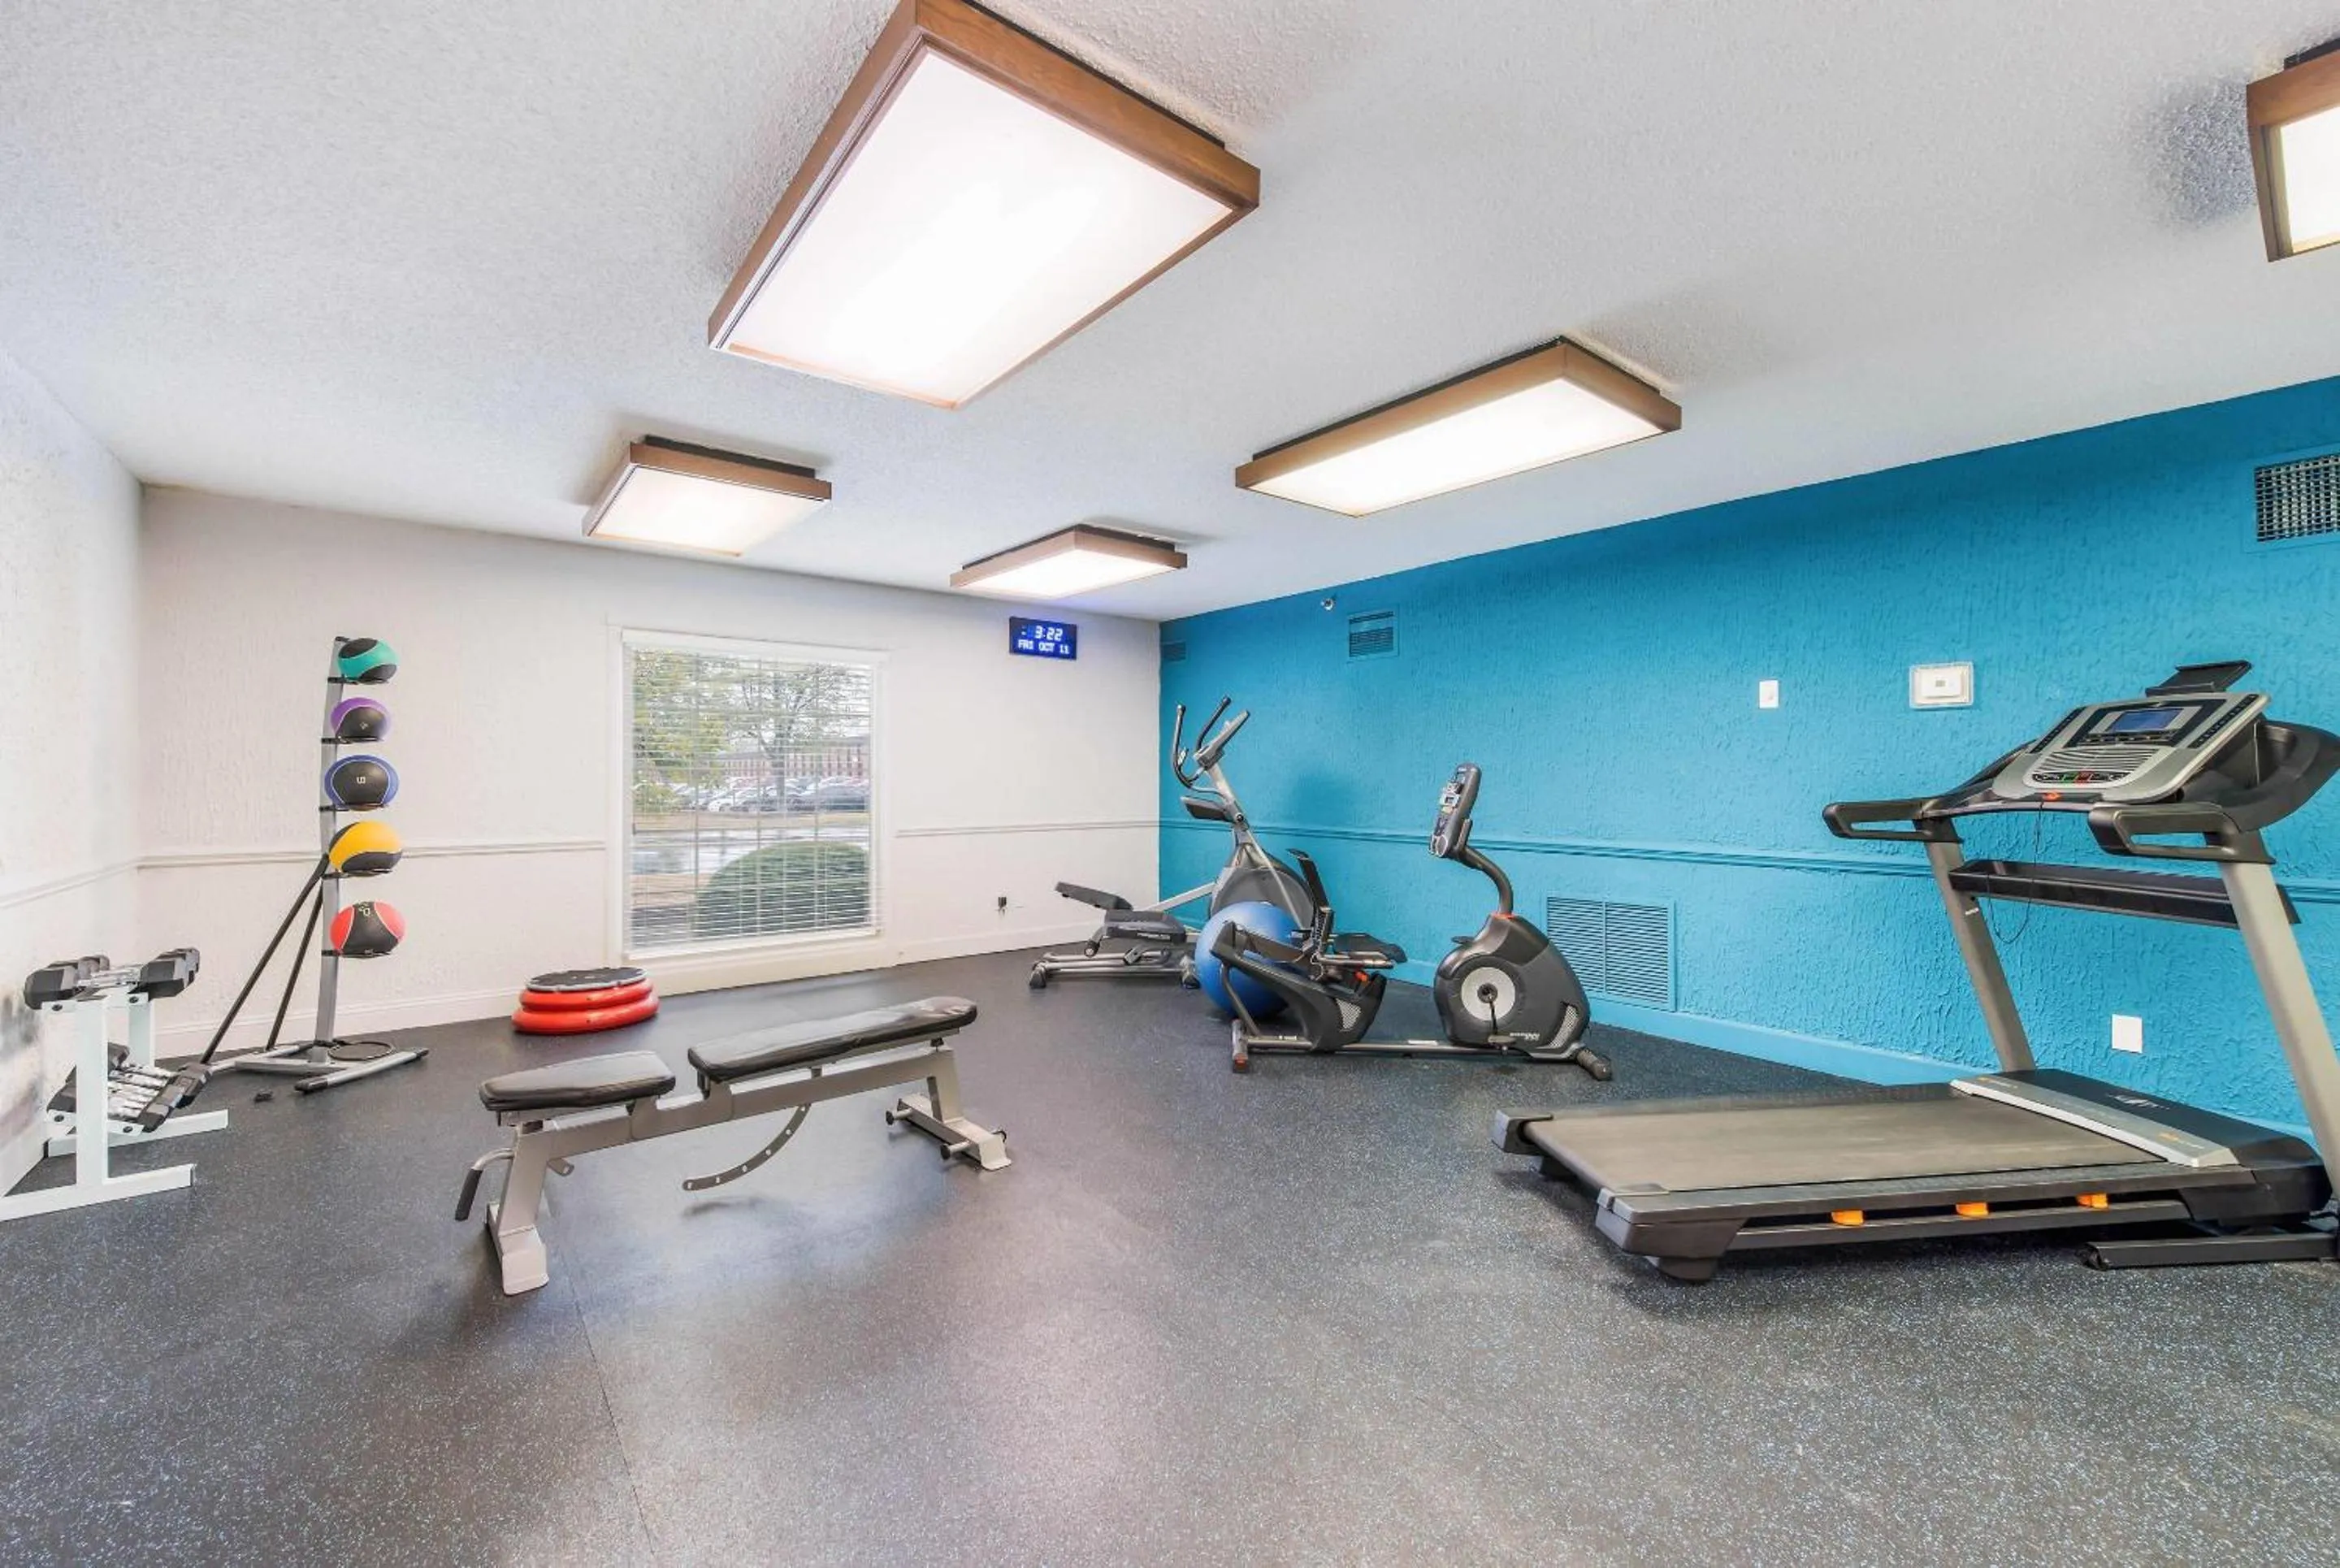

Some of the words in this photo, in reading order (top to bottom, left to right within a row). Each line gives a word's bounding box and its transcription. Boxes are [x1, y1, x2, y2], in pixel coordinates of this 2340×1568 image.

[1035, 626, 1063, 642] 3:22
[1018, 639, 1034, 650] FRI
[1038, 642, 1055, 652] OCT
